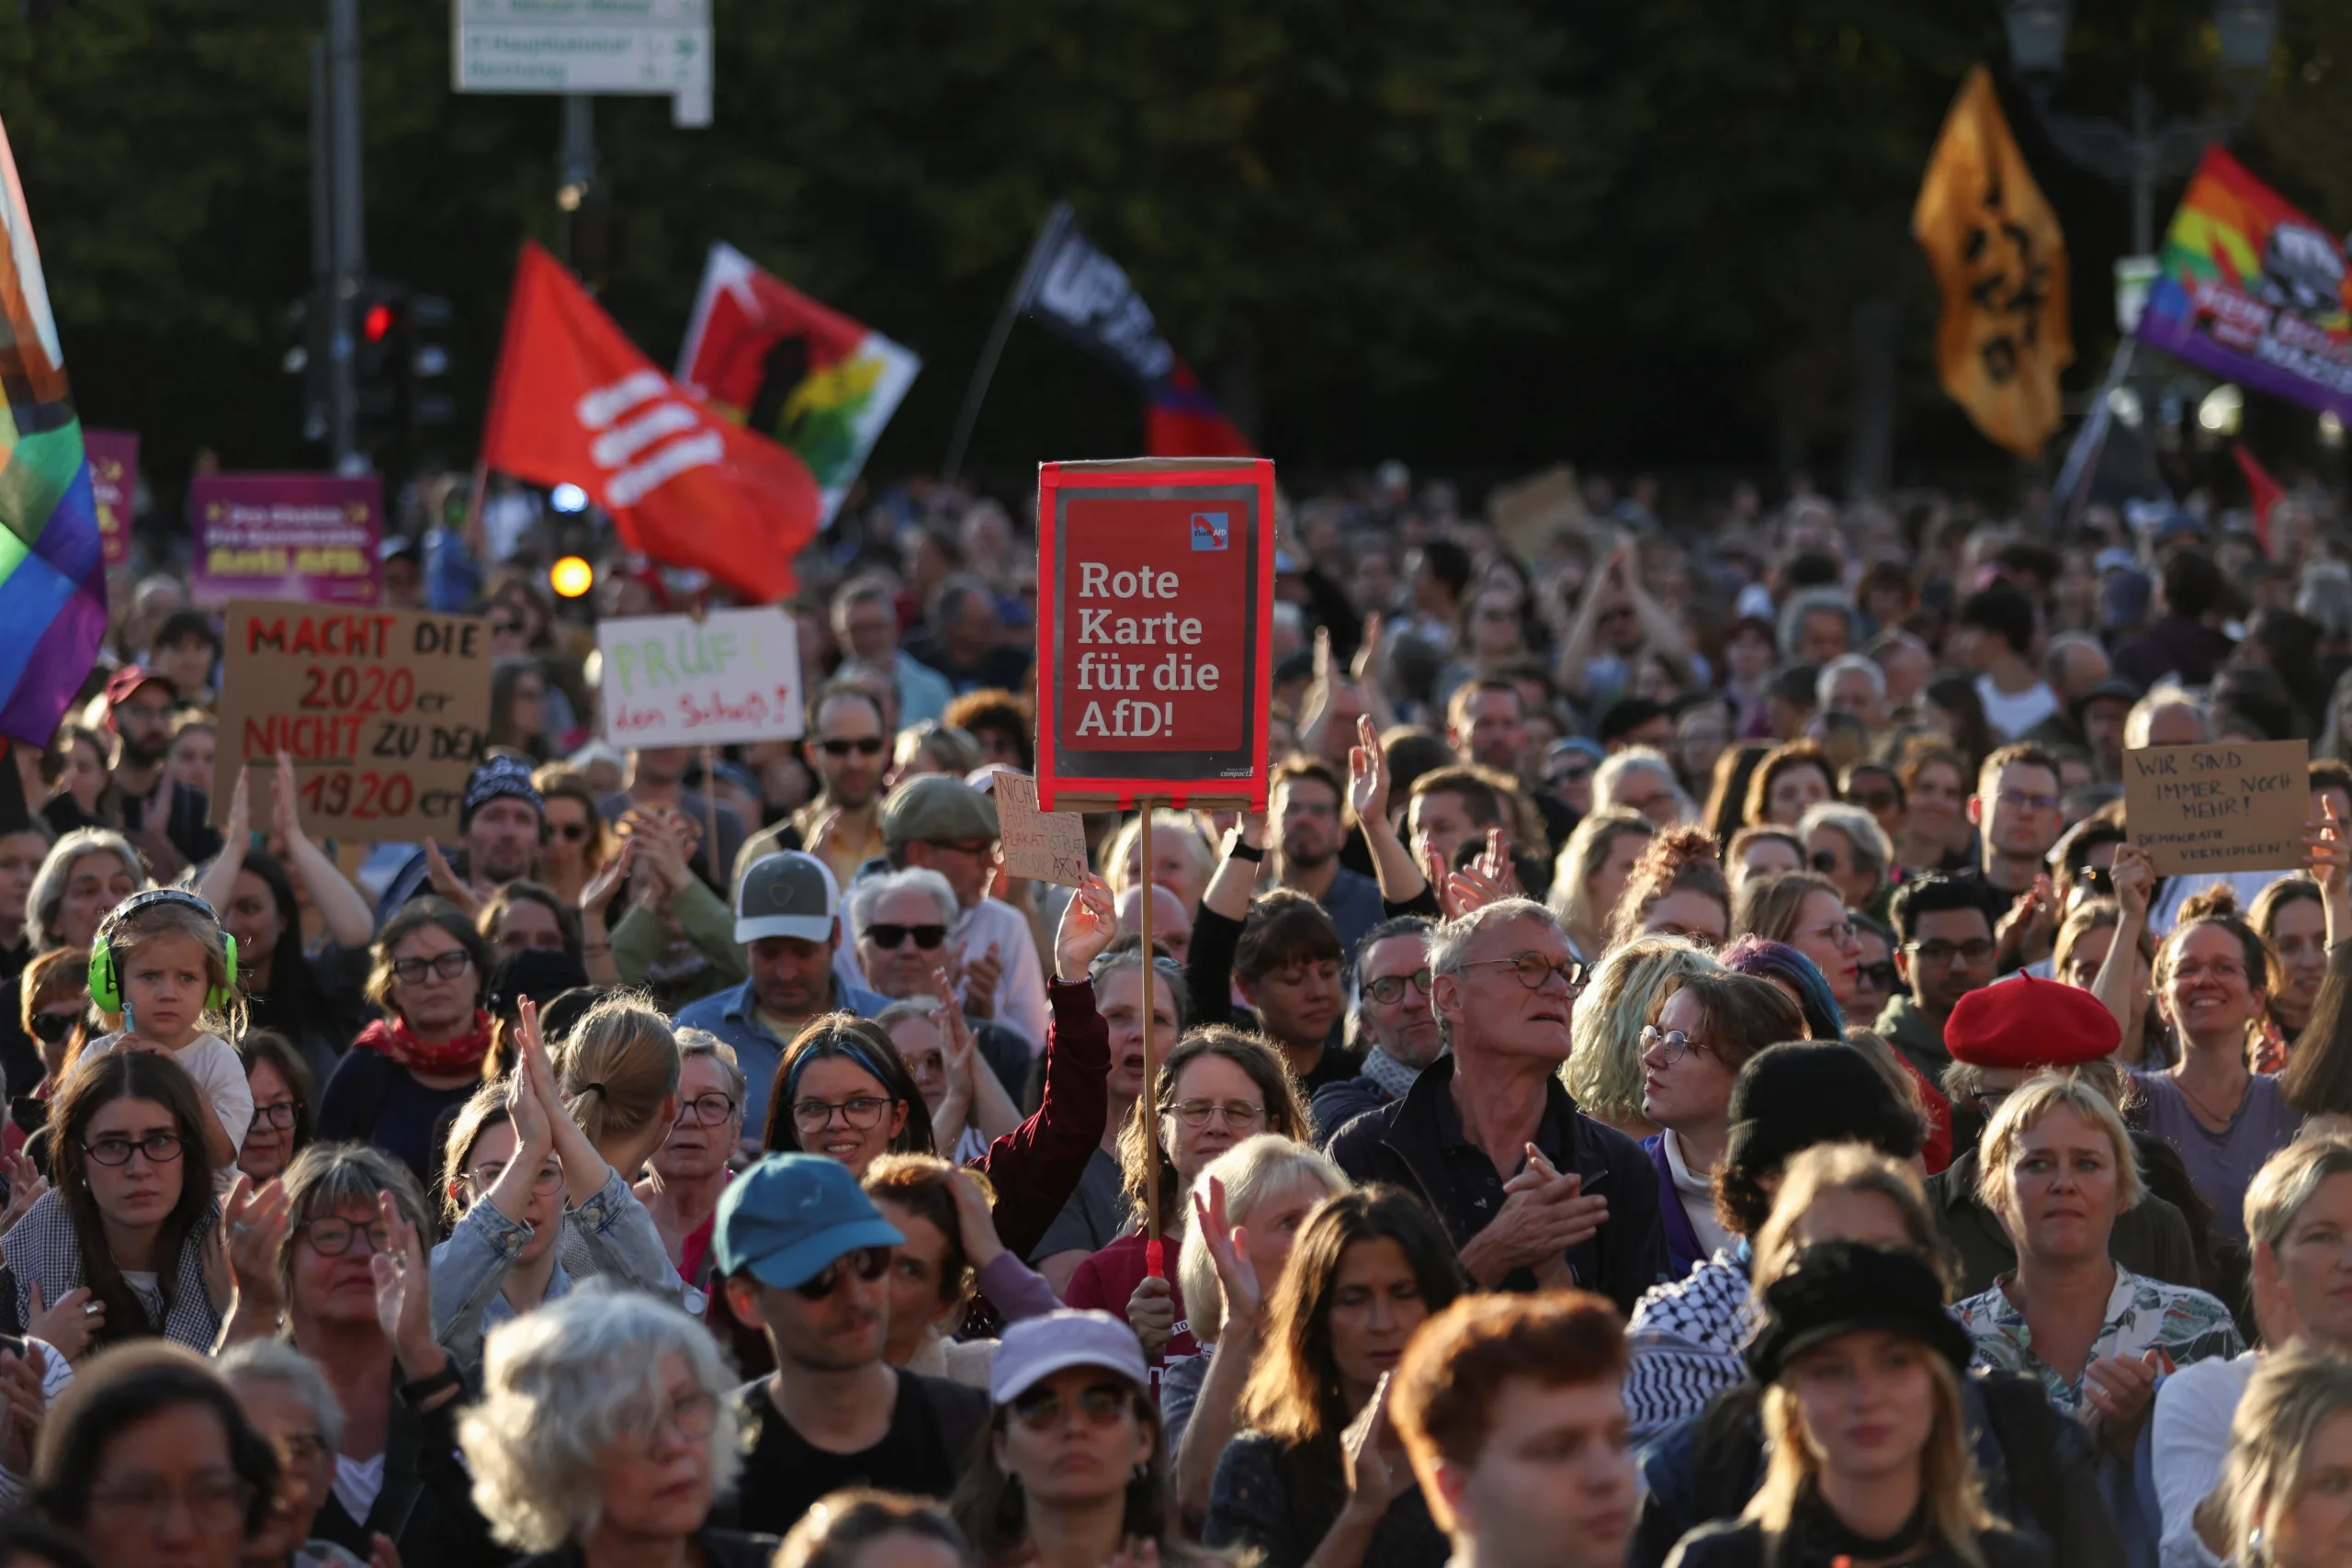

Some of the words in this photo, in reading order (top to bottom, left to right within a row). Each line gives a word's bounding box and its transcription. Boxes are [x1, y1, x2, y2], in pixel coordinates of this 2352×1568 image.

[1079, 562, 1179, 599] Rote
[245, 614, 397, 658] MACHT
[413, 621, 480, 659] DIE
[1078, 608, 1203, 645] Karte
[1077, 652, 1146, 691] für
[1153, 654, 1219, 691] die
[1076, 699, 1173, 737] AfD!
[242, 714, 366, 760] NICHT
[372, 720, 420, 757] ZU
[430, 725, 490, 764] DEN
[2135, 753, 2177, 777] WIR
[2190, 751, 2242, 772] SIND
[2156, 780, 2224, 801] IMMER
[2241, 773, 2291, 793] NOCH
[1003, 829, 1046, 847] PLAKAT
